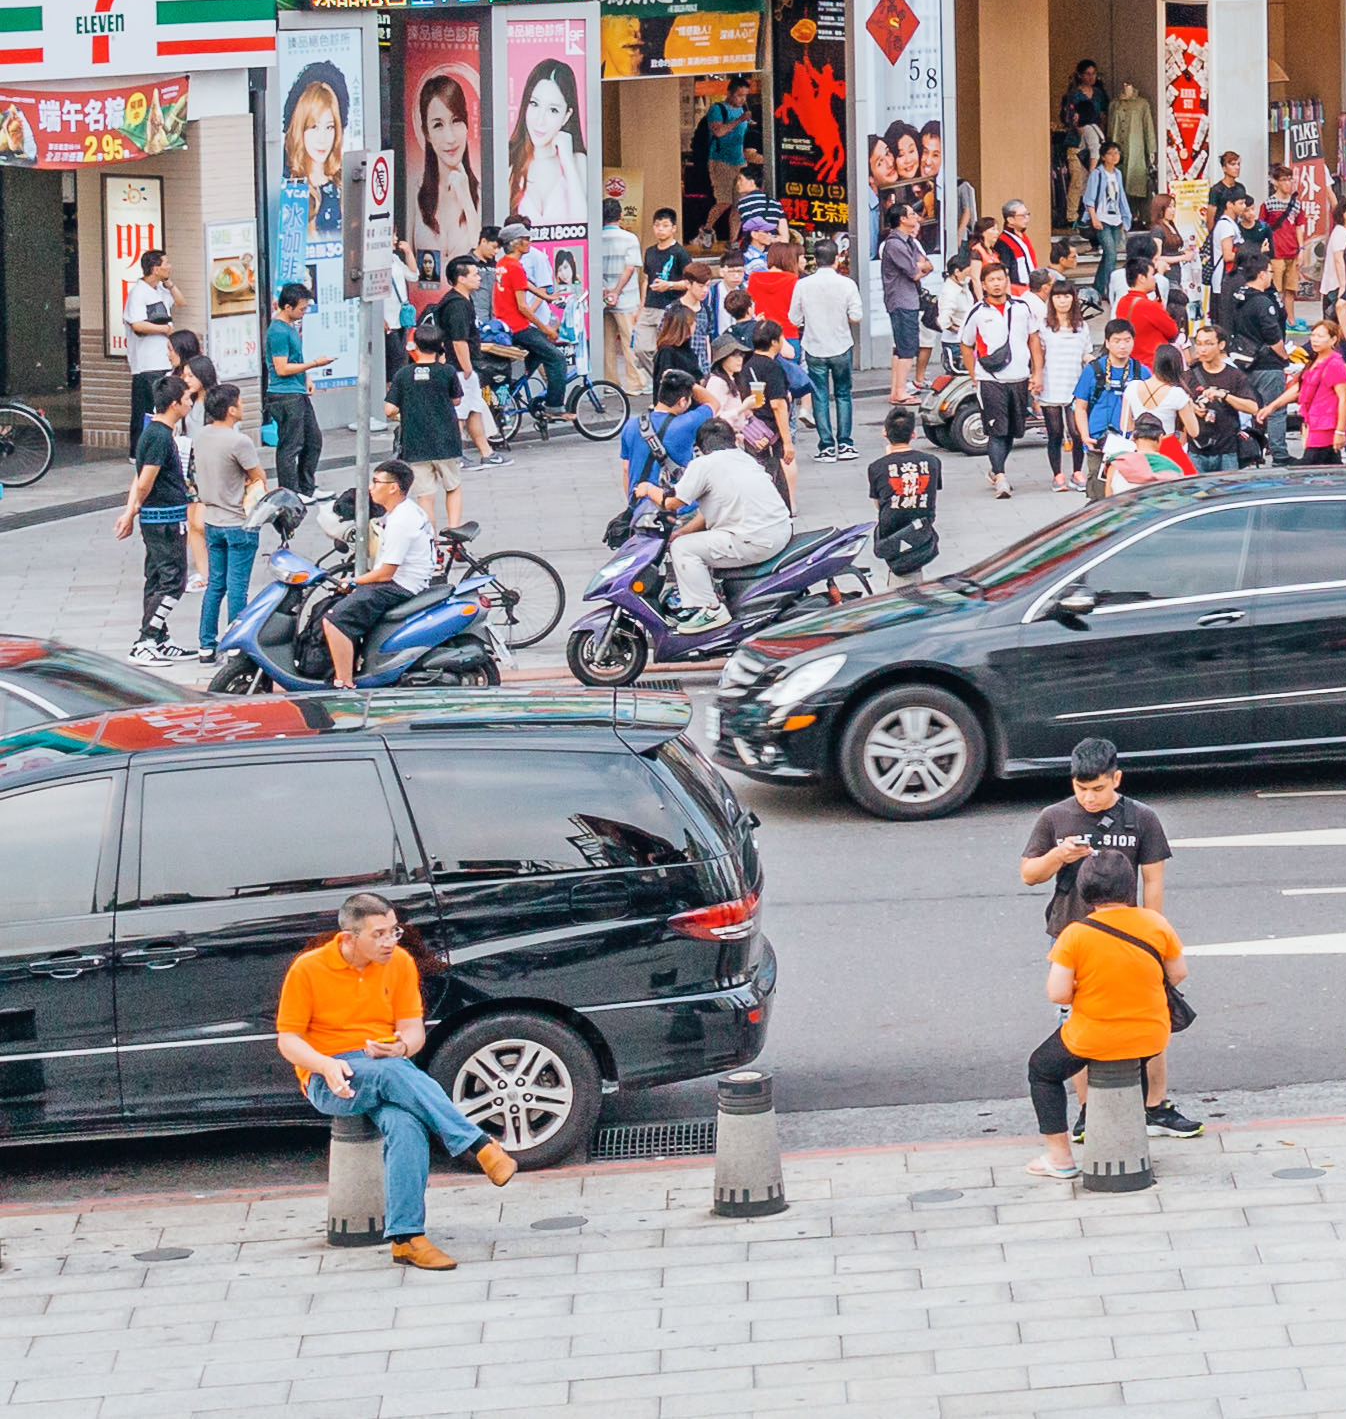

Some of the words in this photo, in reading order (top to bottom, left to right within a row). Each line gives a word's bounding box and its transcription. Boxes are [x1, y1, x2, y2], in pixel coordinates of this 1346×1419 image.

[407, 24, 480, 42] 臻品絕色診所
[506, 24, 566, 38] 臻品絕色診所
[287, 35, 351, 52] 臻品絕色診所
[38, 96, 126, 133] 端午名粽
[1290, 121, 1319, 142] TAKE
[1294, 140, 1319, 159] OUT
[281, 202, 305, 281] 冰咖啡
